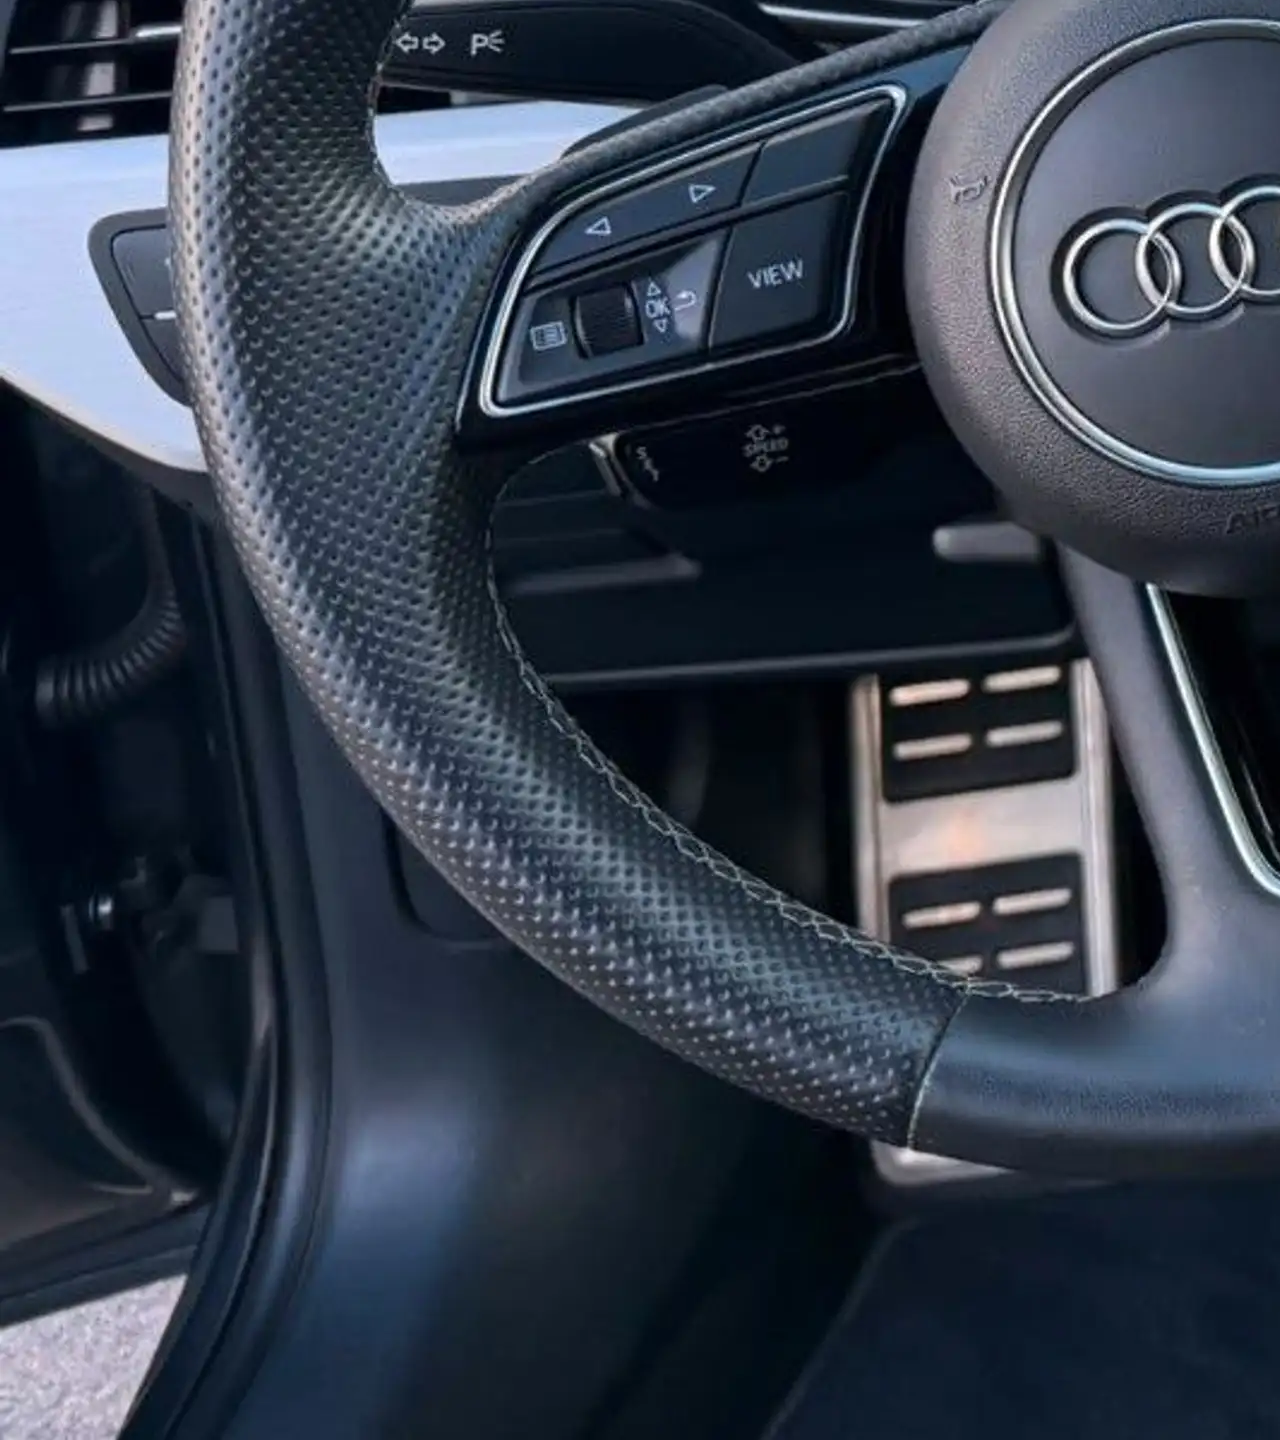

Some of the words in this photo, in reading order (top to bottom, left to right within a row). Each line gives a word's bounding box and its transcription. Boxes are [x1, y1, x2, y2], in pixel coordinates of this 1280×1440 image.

[747, 258, 805, 290] VIEW
[646, 296, 671, 320] OK
[743, 437, 790, 458] SPEED
